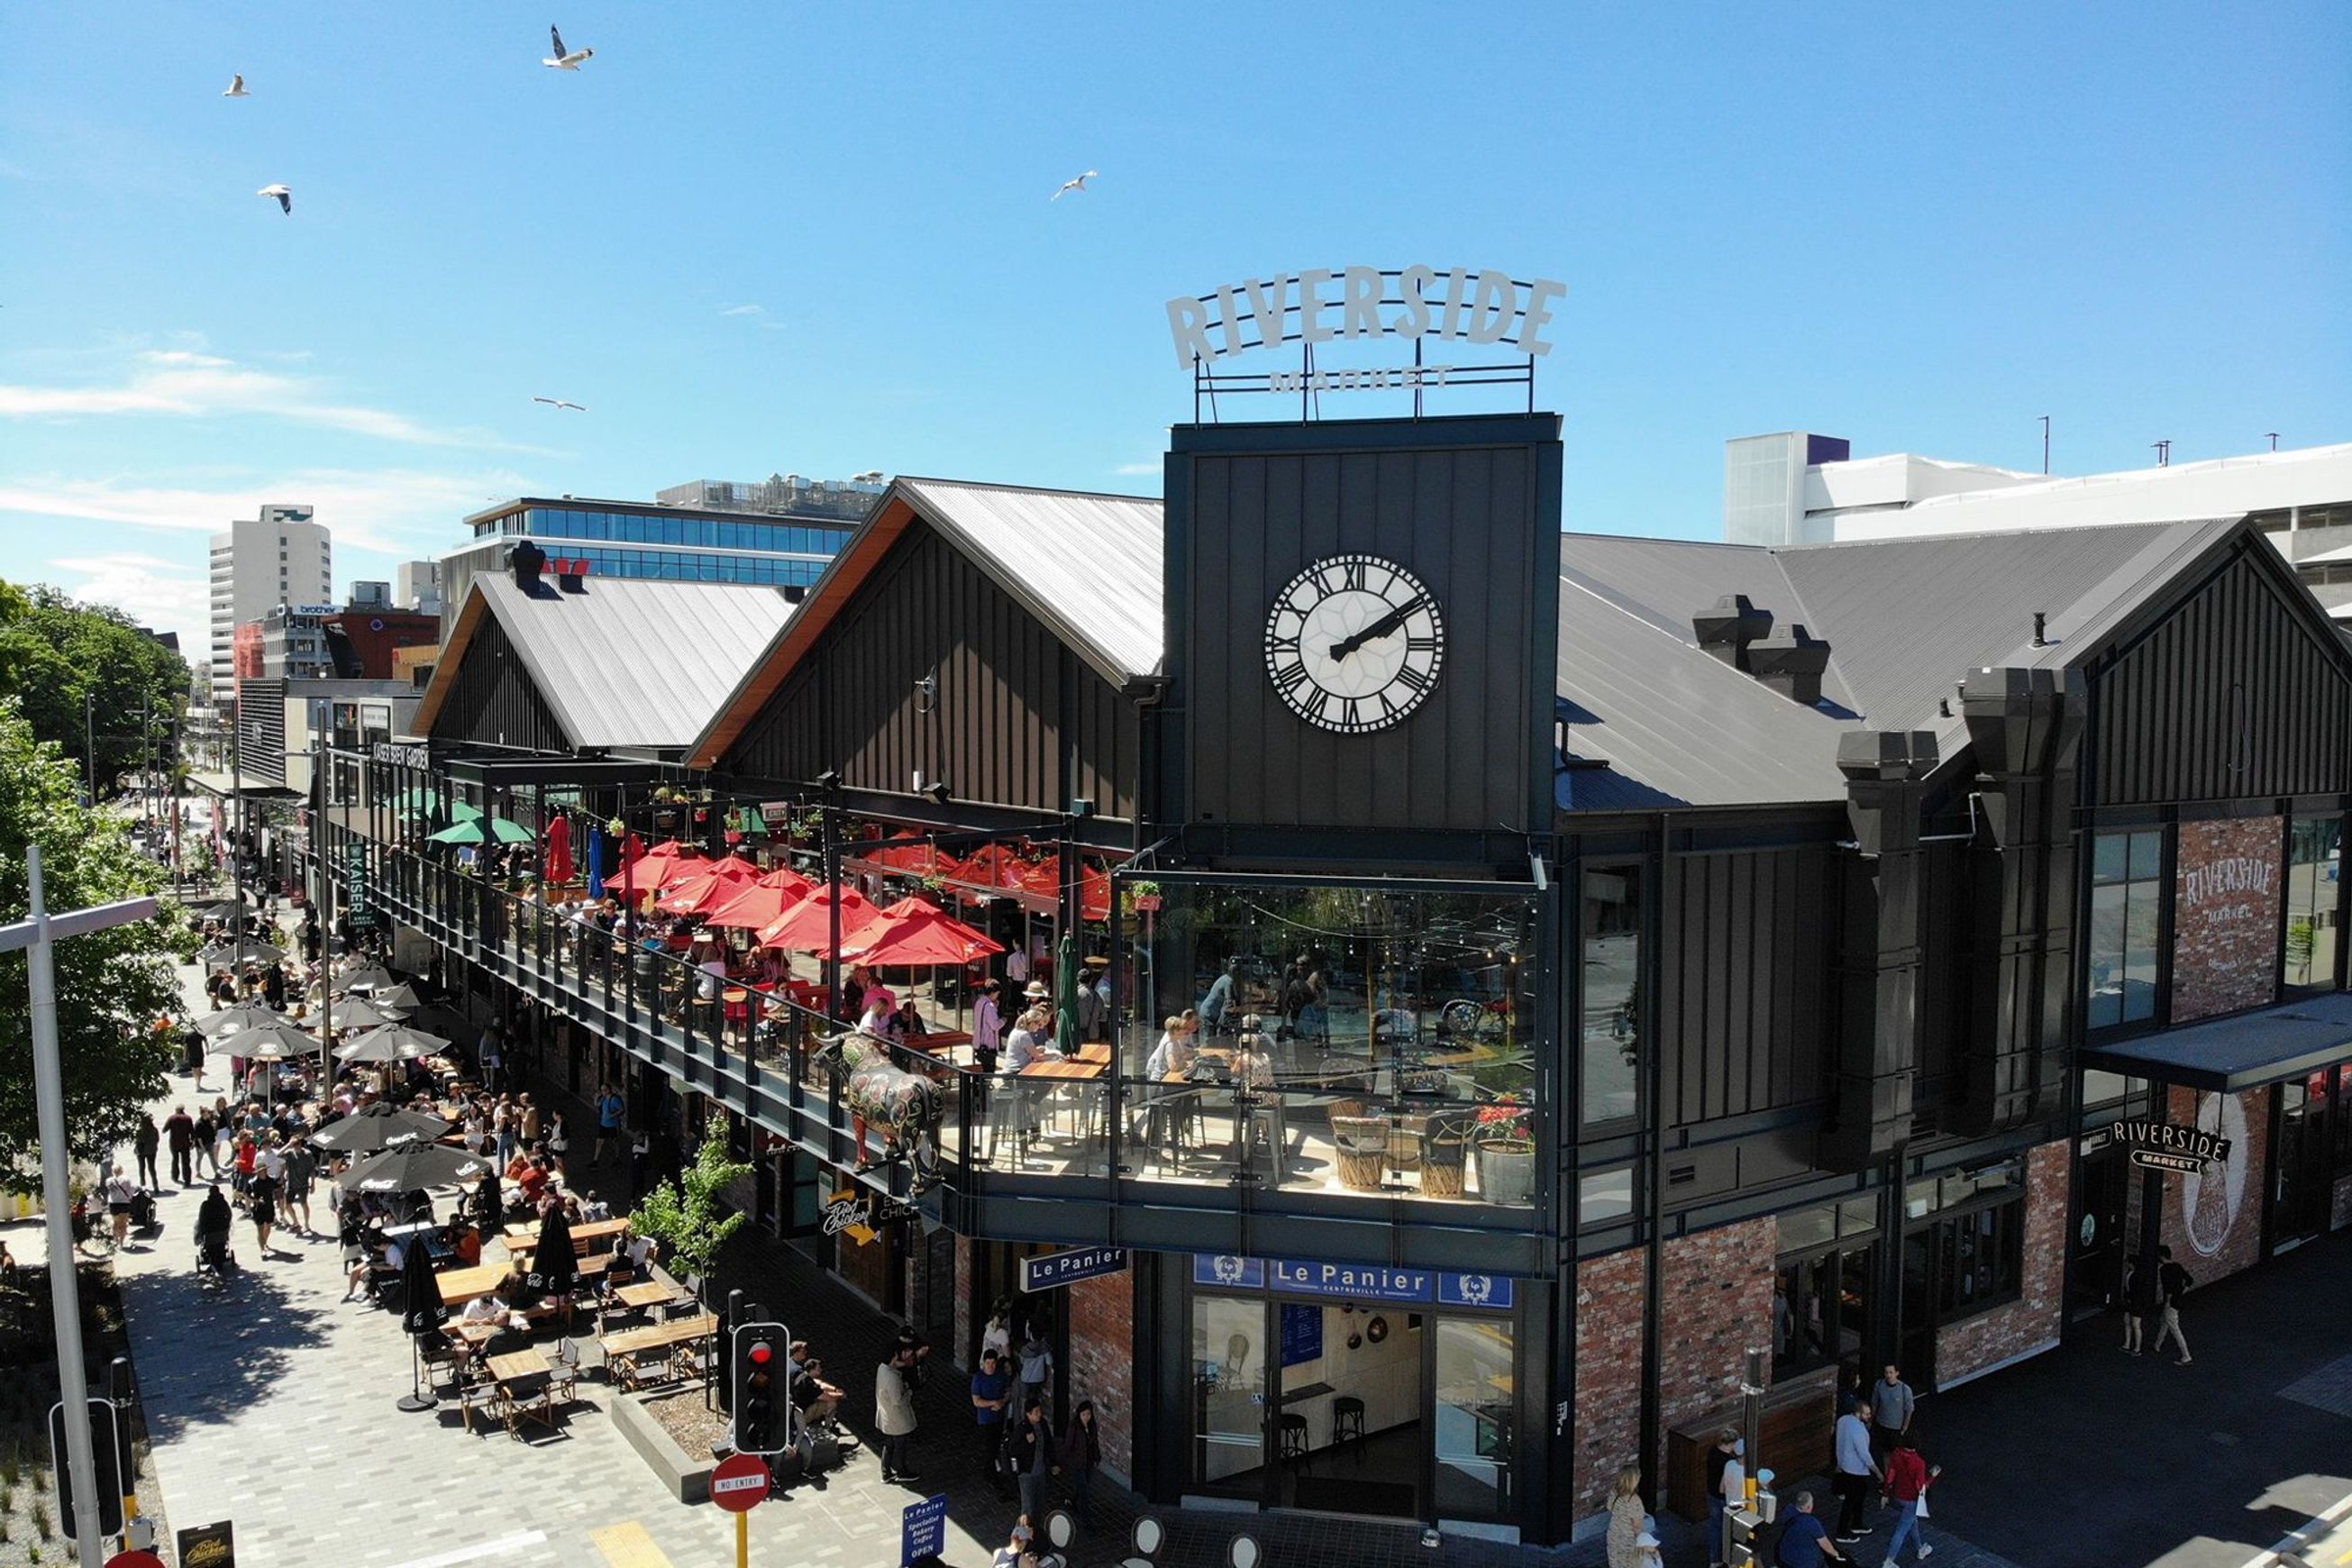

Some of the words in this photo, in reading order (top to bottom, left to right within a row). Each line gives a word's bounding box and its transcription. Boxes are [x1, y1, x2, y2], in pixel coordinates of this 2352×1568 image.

[1165, 264, 1567, 370] RIVERSIDE
[1269, 364, 1454, 394] MARKET
[300, 606, 335, 614] brother
[350, 858, 364, 913] KAISER
[2186, 857, 2273, 907] RIVERSIDE
[2208, 904, 2251, 924] MARKET
[2113, 1121, 2225, 1161] RIVERSIDE
[2141, 1154, 2193, 1169] MARKET
[1033, 1264, 1053, 1278] Le
[1060, 1250, 1122, 1272] Panier
[1278, 1262, 1308, 1281] Le
[1322, 1264, 1425, 1290] Panier
[1323, 1285, 1380, 1295] CENTREVILLE
[720, 1481, 731, 1490] NO
[734, 1478, 757, 1488] ENTRY
[916, 1501, 944, 1516] Panier
[907, 1515, 939, 1531] Specialist
[912, 1526, 934, 1538] Bakery
[912, 1534, 933, 1545] Coffee
[911, 1544, 934, 1558] OPEN
